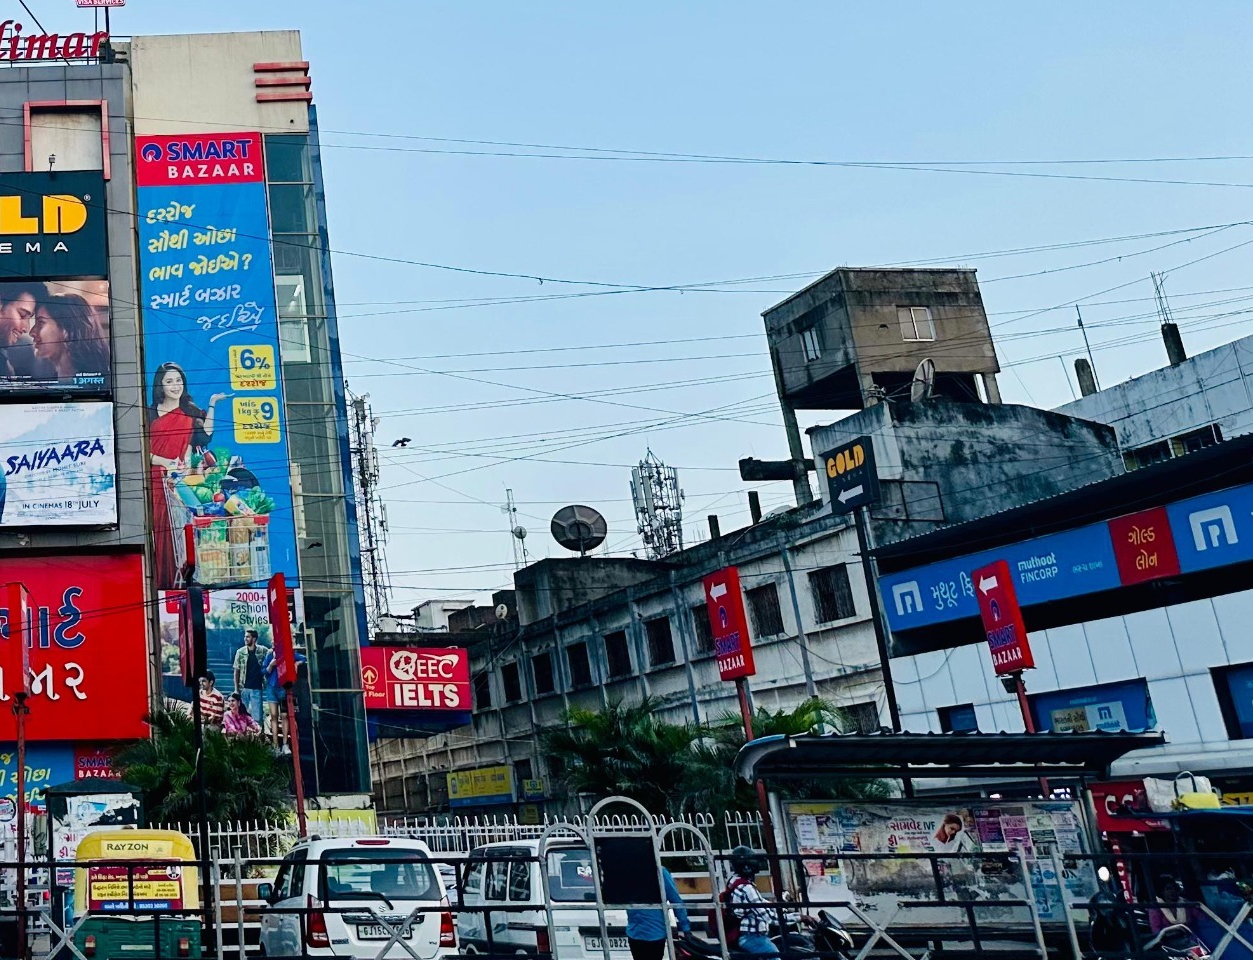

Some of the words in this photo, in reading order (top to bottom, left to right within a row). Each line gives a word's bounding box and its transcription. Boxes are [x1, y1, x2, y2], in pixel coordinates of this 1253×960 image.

[167, 139, 253, 163] SMART
[167, 163, 255, 179] BAZAAR
[146, 201, 196, 224] દરરોજ
[148, 228, 189, 253] સૌથી
[193, 225, 237, 246] ઓછા
[149, 263, 184, 281] ભાવ
[150, 284, 193, 309] સ્માર્ટ
[195, 284, 241, 303] બઝાર
[79, 376, 105, 386] अगस्त
[4, 438, 106, 477] SAIYAARA
[827, 444, 865, 478] GOLD
[32, 502, 63, 510] CINEMAS
[78, 500, 100, 510] JULY
[1128, 525, 1156, 545] ગોલ્ડ
[1017, 552, 1056, 572] muthoot
[1136, 548, 1158, 571] લોન
[1020, 566, 1058, 584] FINCORP
[236, 591, 266, 602] 2000+
[231, 602, 267, 614] Fashion
[239, 614, 269, 626] Styles
[715, 631, 741, 657] SMART
[987, 623, 1016, 651] SMART
[718, 654, 745, 673] BAZAAR
[992, 646, 1022, 666] BAZAAR
[394, 683, 460, 708] IELTS
[78, 757, 113, 768] SMAR
[923, 821, 936, 831] IVF
[107, 843, 148, 851] RAYZON
